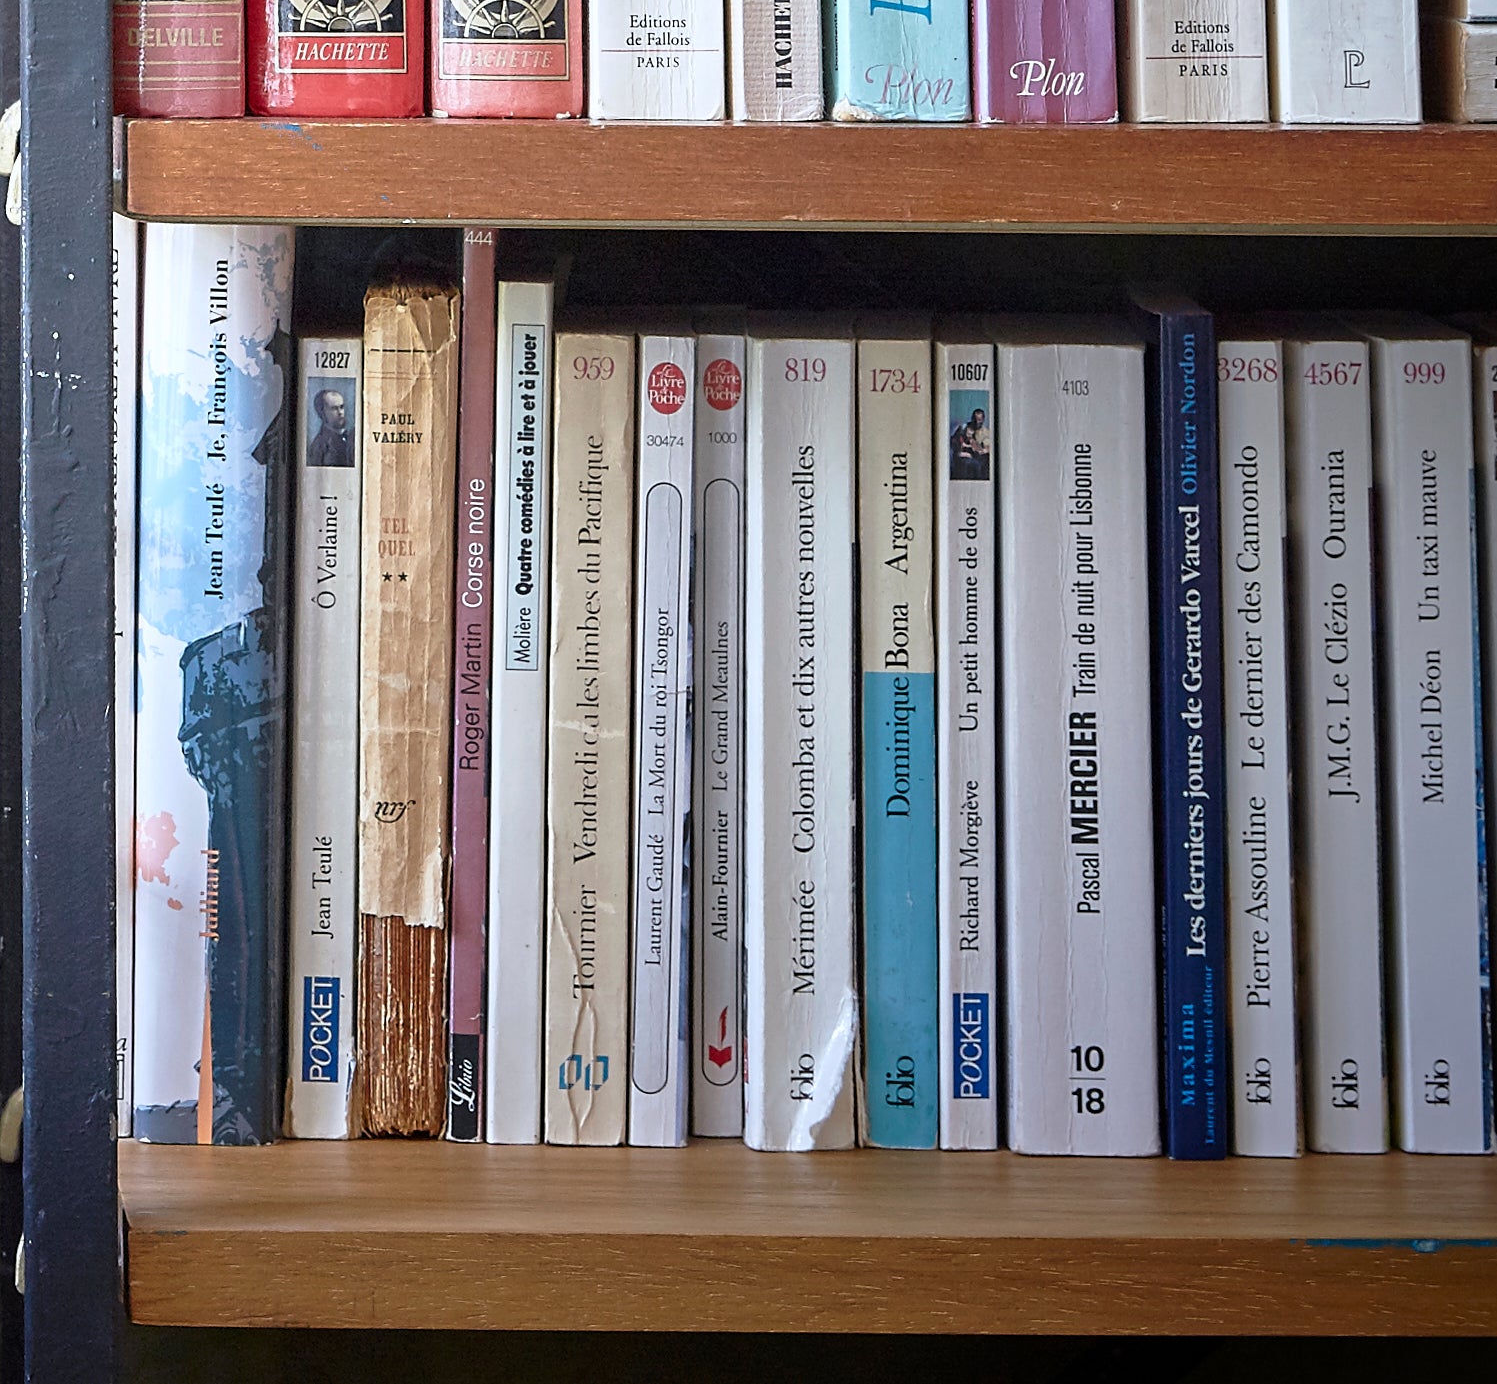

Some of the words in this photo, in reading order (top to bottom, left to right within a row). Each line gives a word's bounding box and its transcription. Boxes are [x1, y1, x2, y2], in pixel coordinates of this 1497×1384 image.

[626, 31, 642, 46] de
[647, 31, 690, 46] Fallois
[629, 13, 687, 29] Editions
[294, 41, 391, 62] HACHETTE
[637, 56, 680, 69] PARIS
[1008, 58, 1085, 98] Plon
[209, 260, 229, 325] Villon
[207, 332, 232, 426] François
[314, 351, 351, 369] 12827
[573, 355, 615, 381] 959
[784, 357, 827, 383] 819
[869, 368, 921, 394] 1734
[951, 363, 989, 381] 10607
[1303, 361, 1363, 386] 4567
[1403, 362, 1446, 385] 999
[372, 429, 423, 444] VALÉRY
[381, 413, 415, 426] PAUL
[646, 434, 685, 448] 30474
[708, 430, 740, 446] 1000
[468, 478, 485, 534] noire
[791, 445, 815, 562] nouvelles
[1068, 443, 1093, 526] Lisbonne
[1320, 449, 1347, 559] Ourania
[1421, 449, 1438, 518] mauve
[205, 483, 225, 539] Teulé
[883, 451, 915, 576] Argentina
[204, 539, 224, 600] Jean
[461, 542, 484, 608] Corse
[1078, 531, 1099, 574] pour
[1416, 535, 1439, 576] taxi
[796, 576, 815, 648] autres
[1070, 584, 1095, 616] nuit
[1417, 586, 1440, 621] Un
[884, 603, 909, 669] Bona
[1071, 621, 1097, 650] de
[1323, 583, 1349, 665] Clézio
[460, 623, 482, 696] Martin
[791, 655, 816, 698] dix
[1072, 652, 1097, 698] Train
[1419, 650, 1442, 714] Déon
[1326, 673, 1350, 706] Le
[460, 704, 488, 772] Roger
[795, 702, 816, 729] et
[885, 679, 917, 818] Dominique
[1326, 716, 1361, 804] J.M.G.
[1420, 723, 1444, 804] Michel
[791, 735, 816, 852] Colomba
[1069, 712, 1099, 845] MERCIER
[311, 836, 333, 890] Teulé
[1075, 852, 1101, 914] Pascal
[310, 897, 334, 940] Jean
[791, 880, 815, 996] Mérimée
[307, 977, 337, 1083] POCKET
[790, 1053, 814, 1101] folio
[1070, 1045, 1105, 1072] 10
[1245, 1057, 1272, 1104] folio
[1424, 1058, 1451, 1106] folio
[1071, 1087, 1105, 1115] 18
[1331, 1058, 1359, 1110] folio
